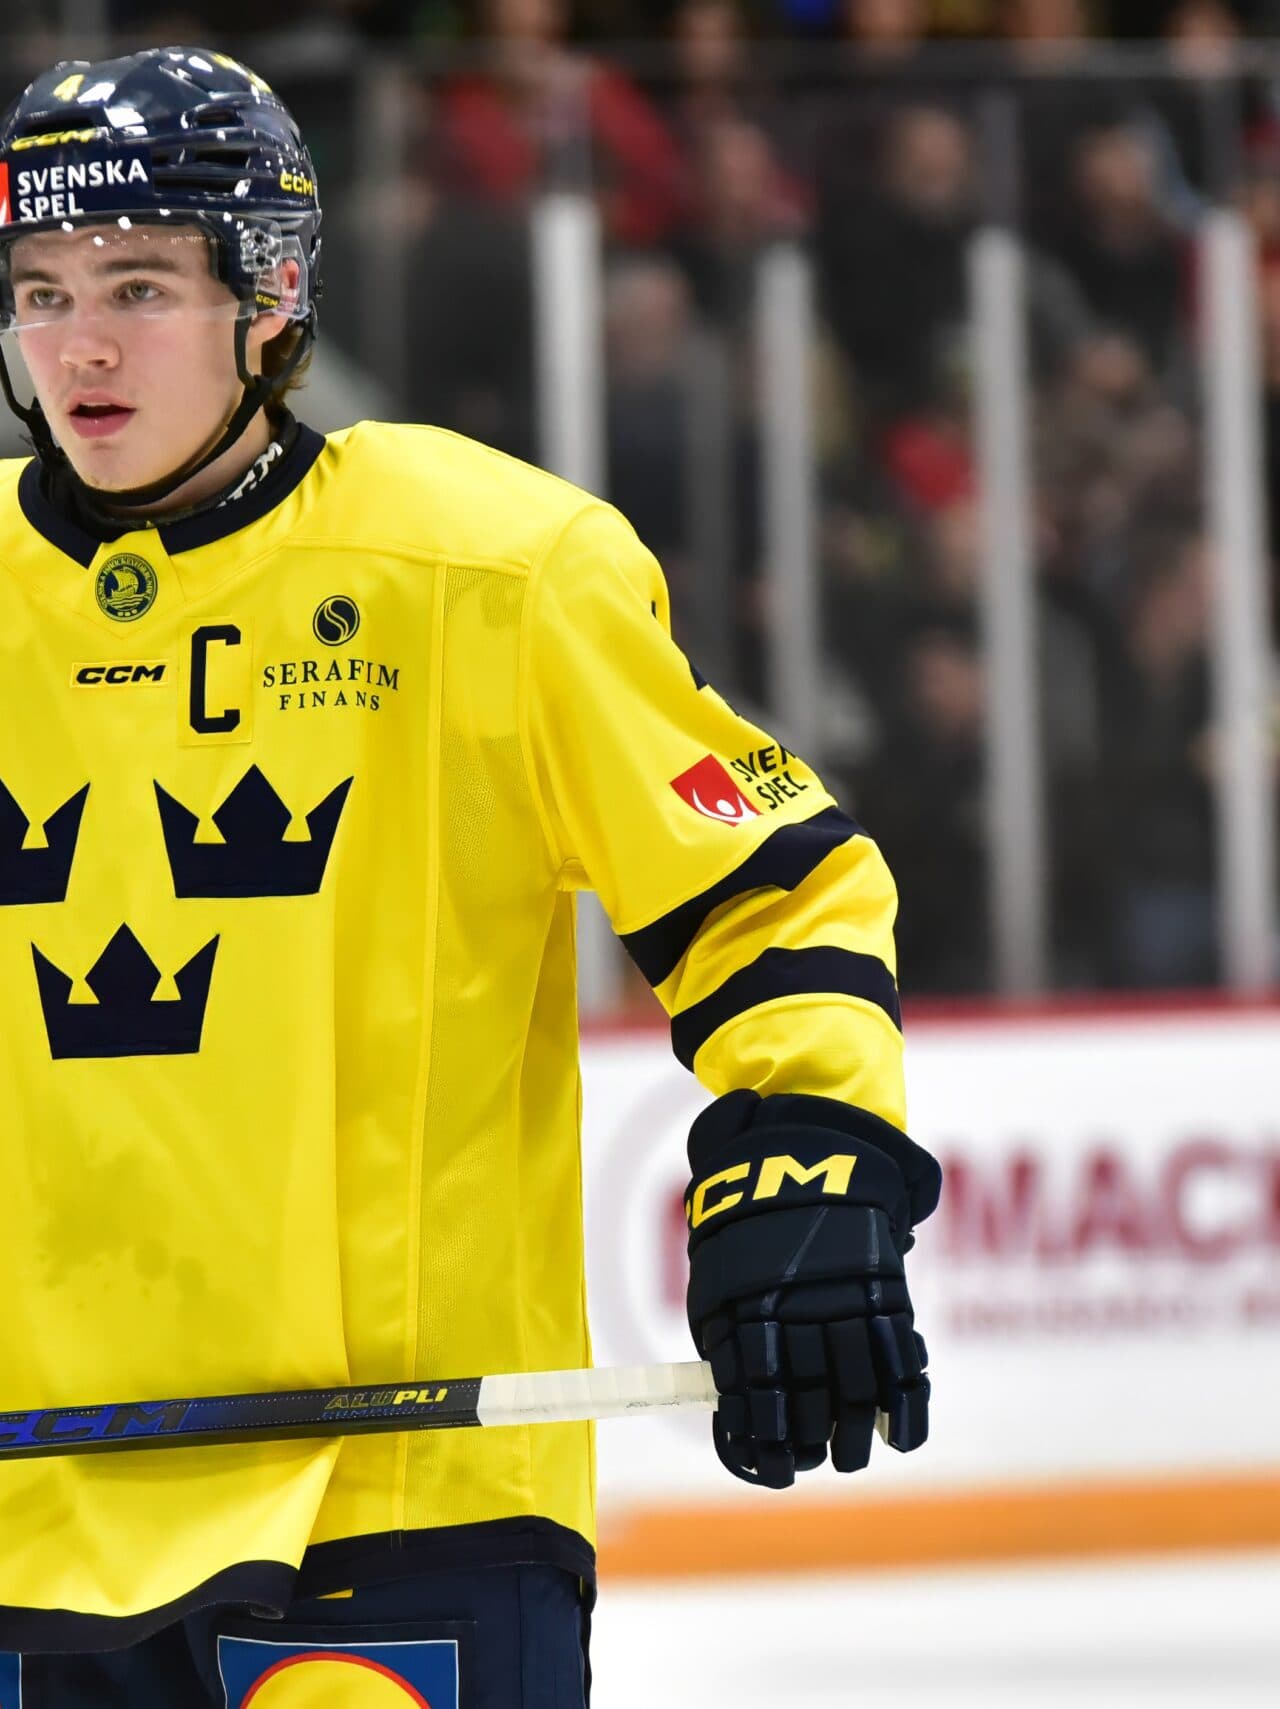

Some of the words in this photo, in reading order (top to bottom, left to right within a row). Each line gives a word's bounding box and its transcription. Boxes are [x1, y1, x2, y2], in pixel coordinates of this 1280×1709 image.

[53, 74, 84, 102] 4
[11, 128, 97, 151] CCM
[17, 158, 149, 197] SVENSKA
[279, 172, 314, 196] CCM
[18, 192, 85, 223] SPEL
[255, 294, 280, 307] CCM
[76, 664, 166, 685] CCM
[190, 624, 242, 734] C
[263, 659, 400, 691] SERAFIM
[279, 690, 380, 711] FINANS
[756, 770, 809, 811] SPEL
[686, 1154, 857, 1229] CM
